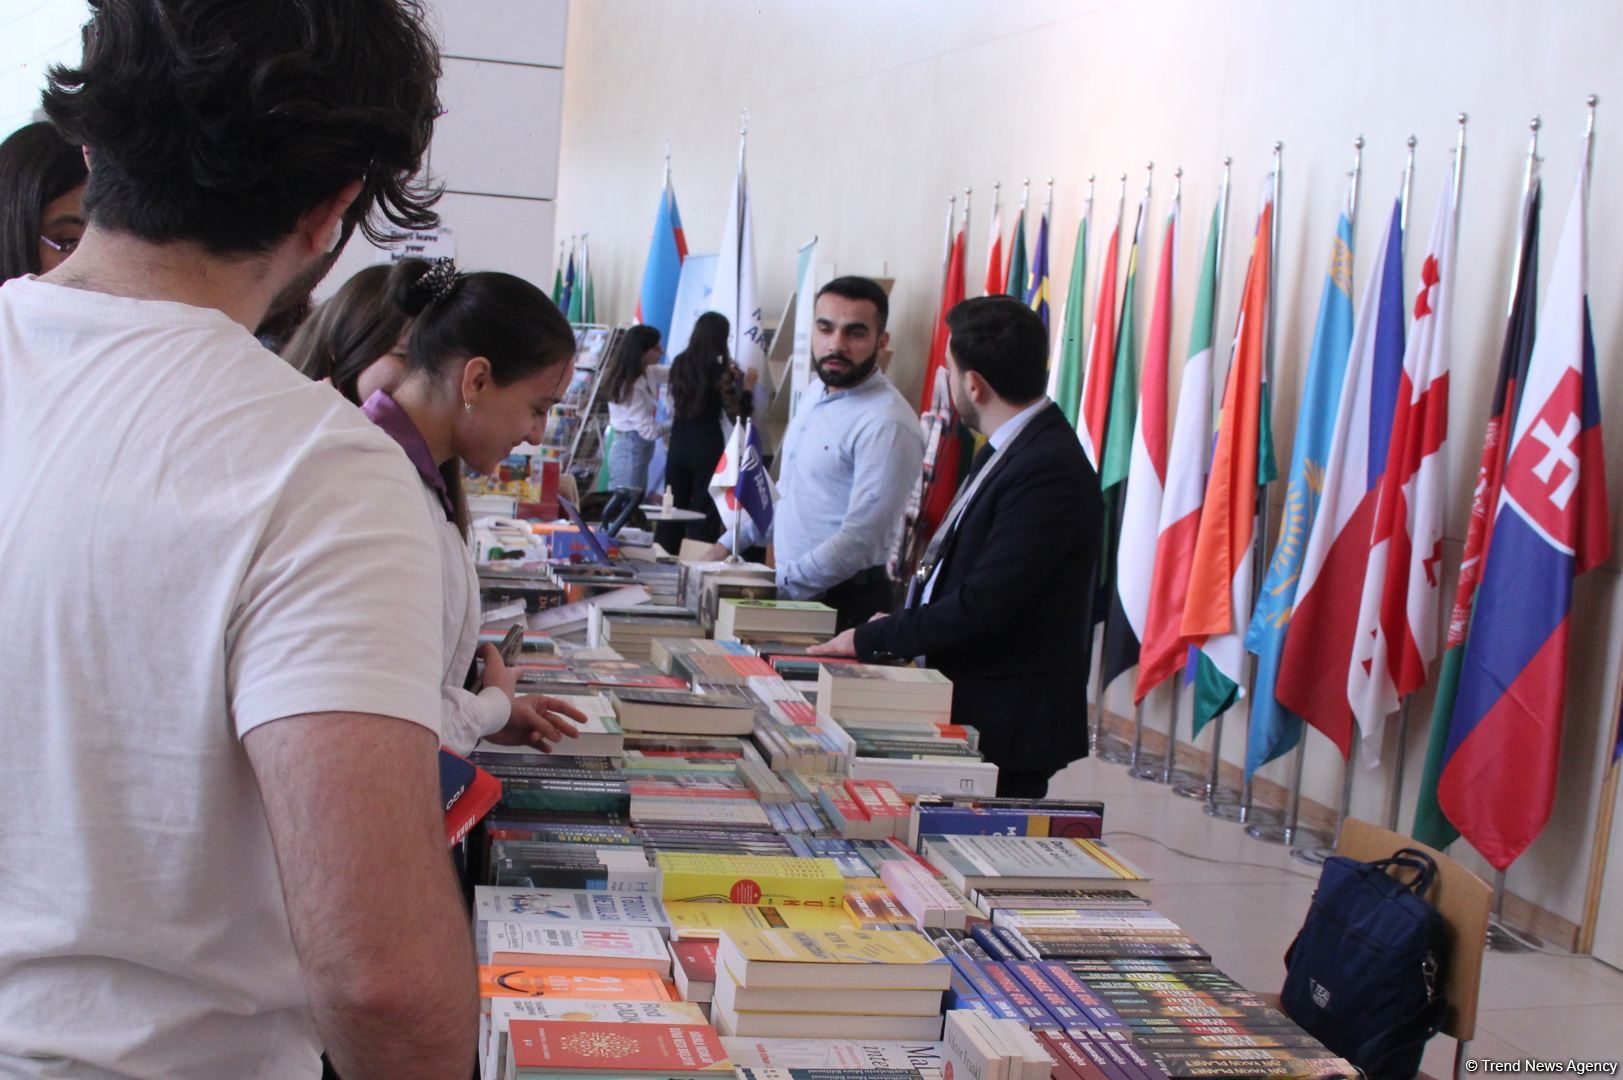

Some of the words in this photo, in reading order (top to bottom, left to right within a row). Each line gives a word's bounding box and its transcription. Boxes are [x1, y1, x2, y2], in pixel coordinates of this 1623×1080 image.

[416, 232, 438, 242] leave
[406, 244, 425, 253] your
[612, 1002, 645, 1024] CADK
[640, 1002, 665, 1017] Rod
[863, 1046, 890, 1069] inte
